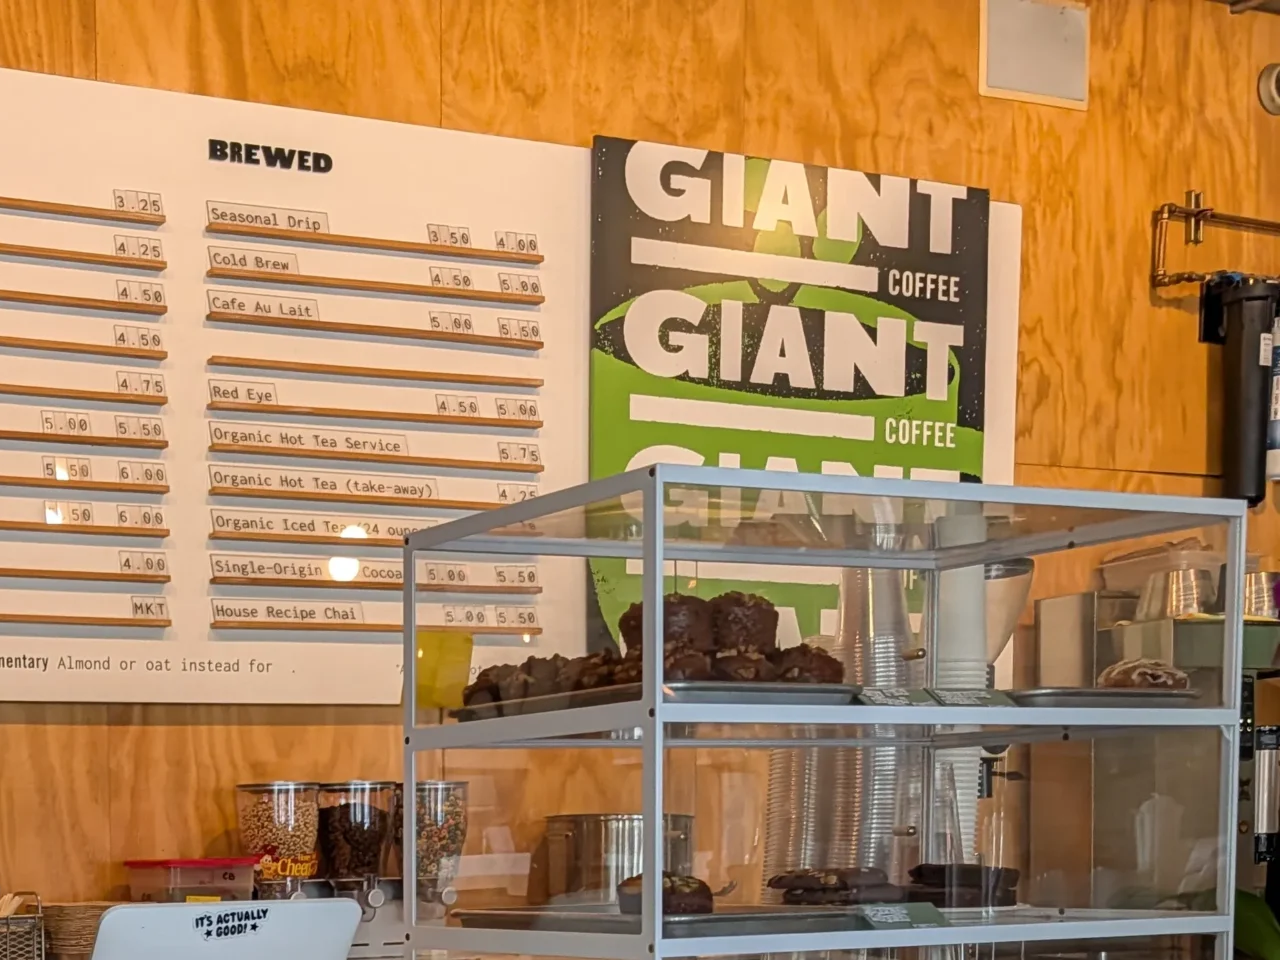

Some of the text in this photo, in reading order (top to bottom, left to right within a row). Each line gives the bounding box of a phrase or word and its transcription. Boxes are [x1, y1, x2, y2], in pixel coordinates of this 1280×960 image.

[208, 138, 334, 174] BREWED
[116, 195, 161, 212] 3.25
[624, 140, 967, 255] GIANT
[211, 207, 537, 251] Seasonal Drip 3.50 4.00
[117, 242, 161, 258] 4.25
[213, 253, 539, 293] Cold Brew 4.50 5.00
[120, 287, 163, 303] 4.50
[889, 269, 960, 302] COFFEE
[212, 297, 539, 338] Cafe Au Lait 5.00 5.50
[118, 332, 161, 348] 4.50
[623, 289, 964, 401] GIANT
[120, 378, 163, 394] 4.75
[213, 386, 537, 417] Red Eye 4.50 5.00
[44, 417, 88, 433] 5.00
[118, 422, 162, 437] 5.50
[885, 417, 956, 448] COFFEE
[213, 428, 539, 463] Organic Hot Tea Service 5.75
[121, 467, 165, 482] 6.00
[213, 471, 434, 499] Organic Hot Tea (take-away)
[120, 510, 164, 525] 6.00
[215, 515, 346, 536] Organic Iced Tea
[123, 557, 166, 573] 4.00
[215, 561, 536, 583] Single-Origin Cocoa 5.00 5.50
[134, 602, 166, 617] MKT
[216, 606, 535, 624] House Recipe Chai 5.00 5.50
[57, 655, 111, 671] Almond
[120, 660, 137, 672] or
[146, 658, 172, 672] oat
[182, 657, 241, 673] instead
[249, 657, 273, 674] for
[195, 908, 269, 929] IT'S ACTUALLY
[216, 924, 248, 937] GOOD!
